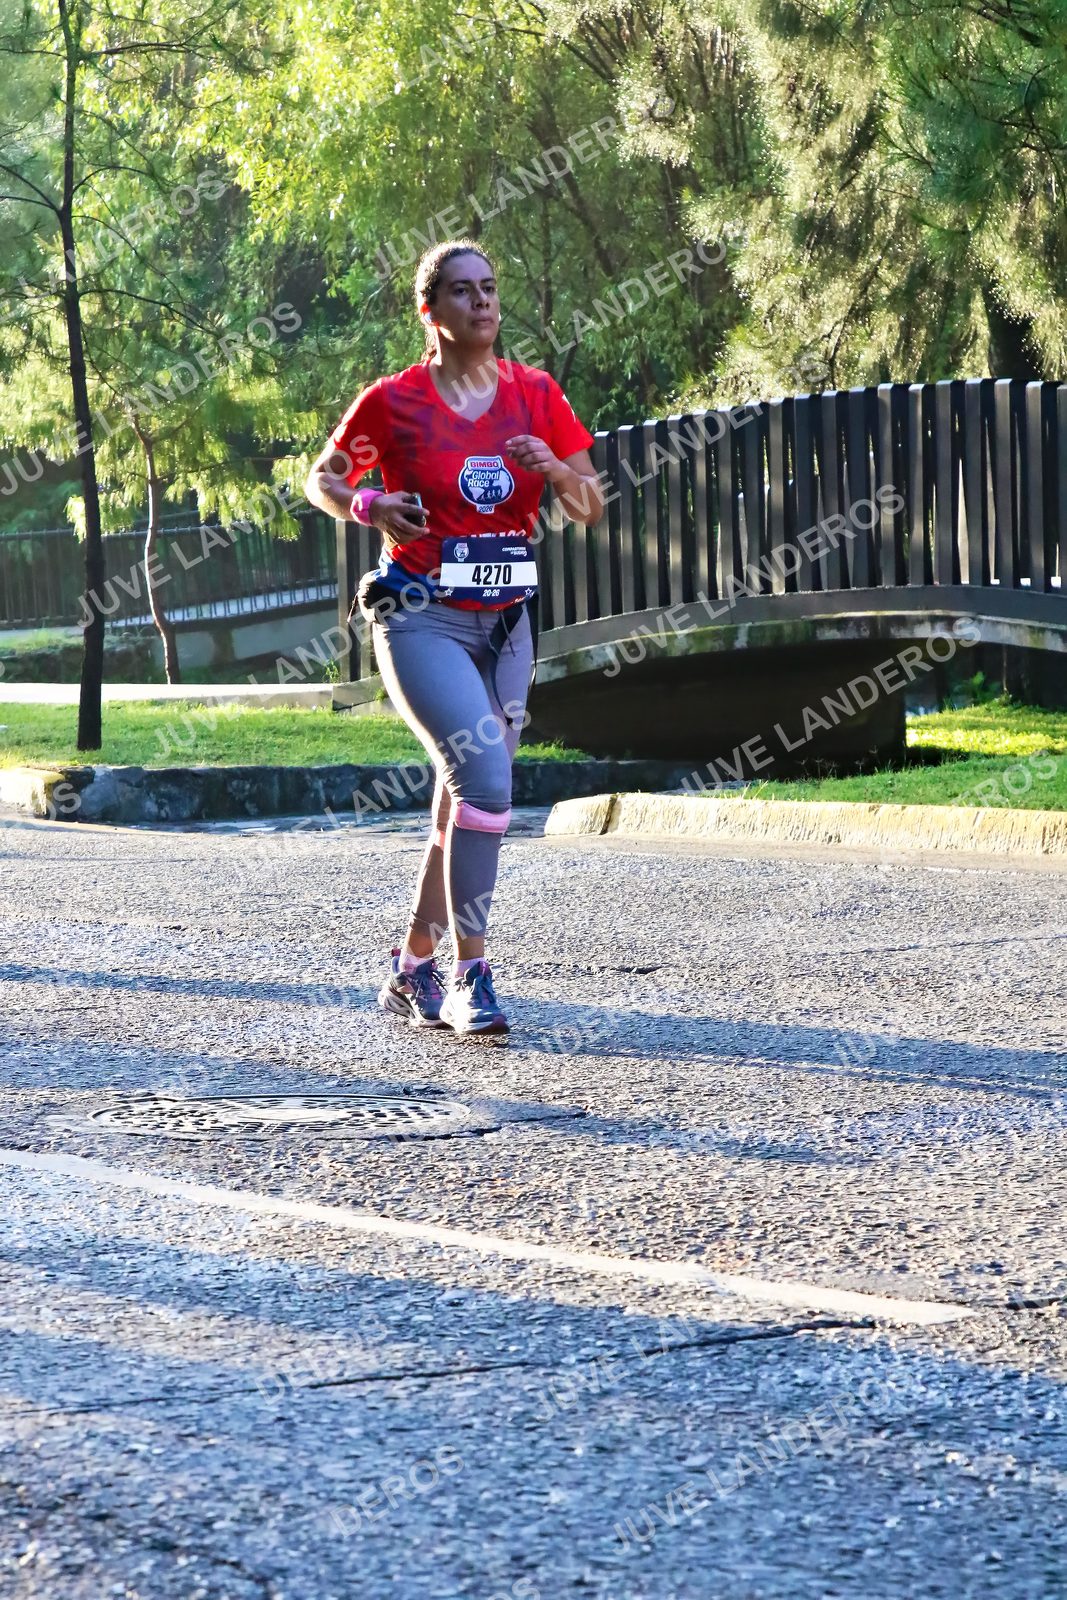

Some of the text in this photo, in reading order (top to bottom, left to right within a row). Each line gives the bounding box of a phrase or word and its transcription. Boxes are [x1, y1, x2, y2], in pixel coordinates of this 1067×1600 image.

[472, 471, 499, 480] Global
[467, 479, 490, 488] Race
[472, 564, 512, 585] 4270
